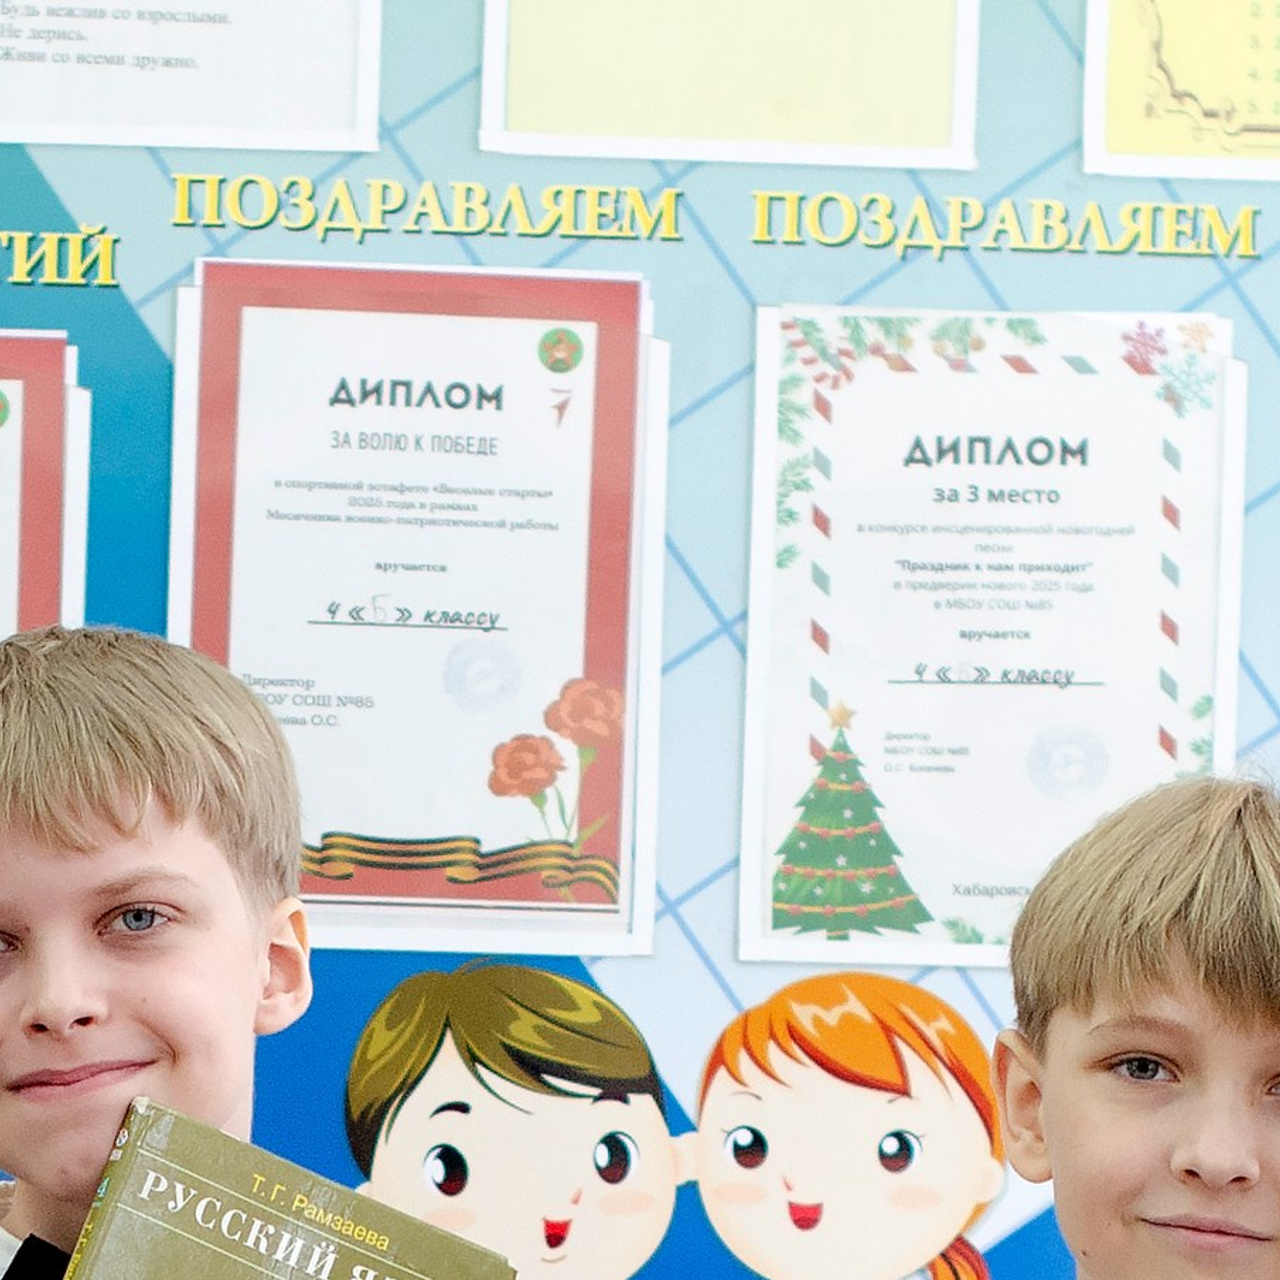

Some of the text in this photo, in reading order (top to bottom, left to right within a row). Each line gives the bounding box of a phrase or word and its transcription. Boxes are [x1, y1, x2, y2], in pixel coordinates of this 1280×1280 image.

[0, 22, 22, 40] Не
[171, 174, 683, 243] ПОЗДРАВЛЯЕМ
[751, 190, 1261, 261] ПОЗДРАВЛЯЕМ
[328, 377, 505, 411] ДИПЛОМ
[330, 430, 499, 457] ЗА ВОЛЮ К ПОБЕДЕ
[903, 434, 1090, 467] ДИПЛОМ
[932, 484, 1062, 504] за 3 место
[374, 560, 448, 574] вручается
[326, 601, 501, 633] 4 классу
[959, 628, 1032, 642] вручается
[914, 662, 1076, 690] 4 классу
[291, 693, 375, 709] СОШ №85
[310, 713, 341, 727] О.С.
[252, 1174, 391, 1252] Т. Г. Рамзаева
